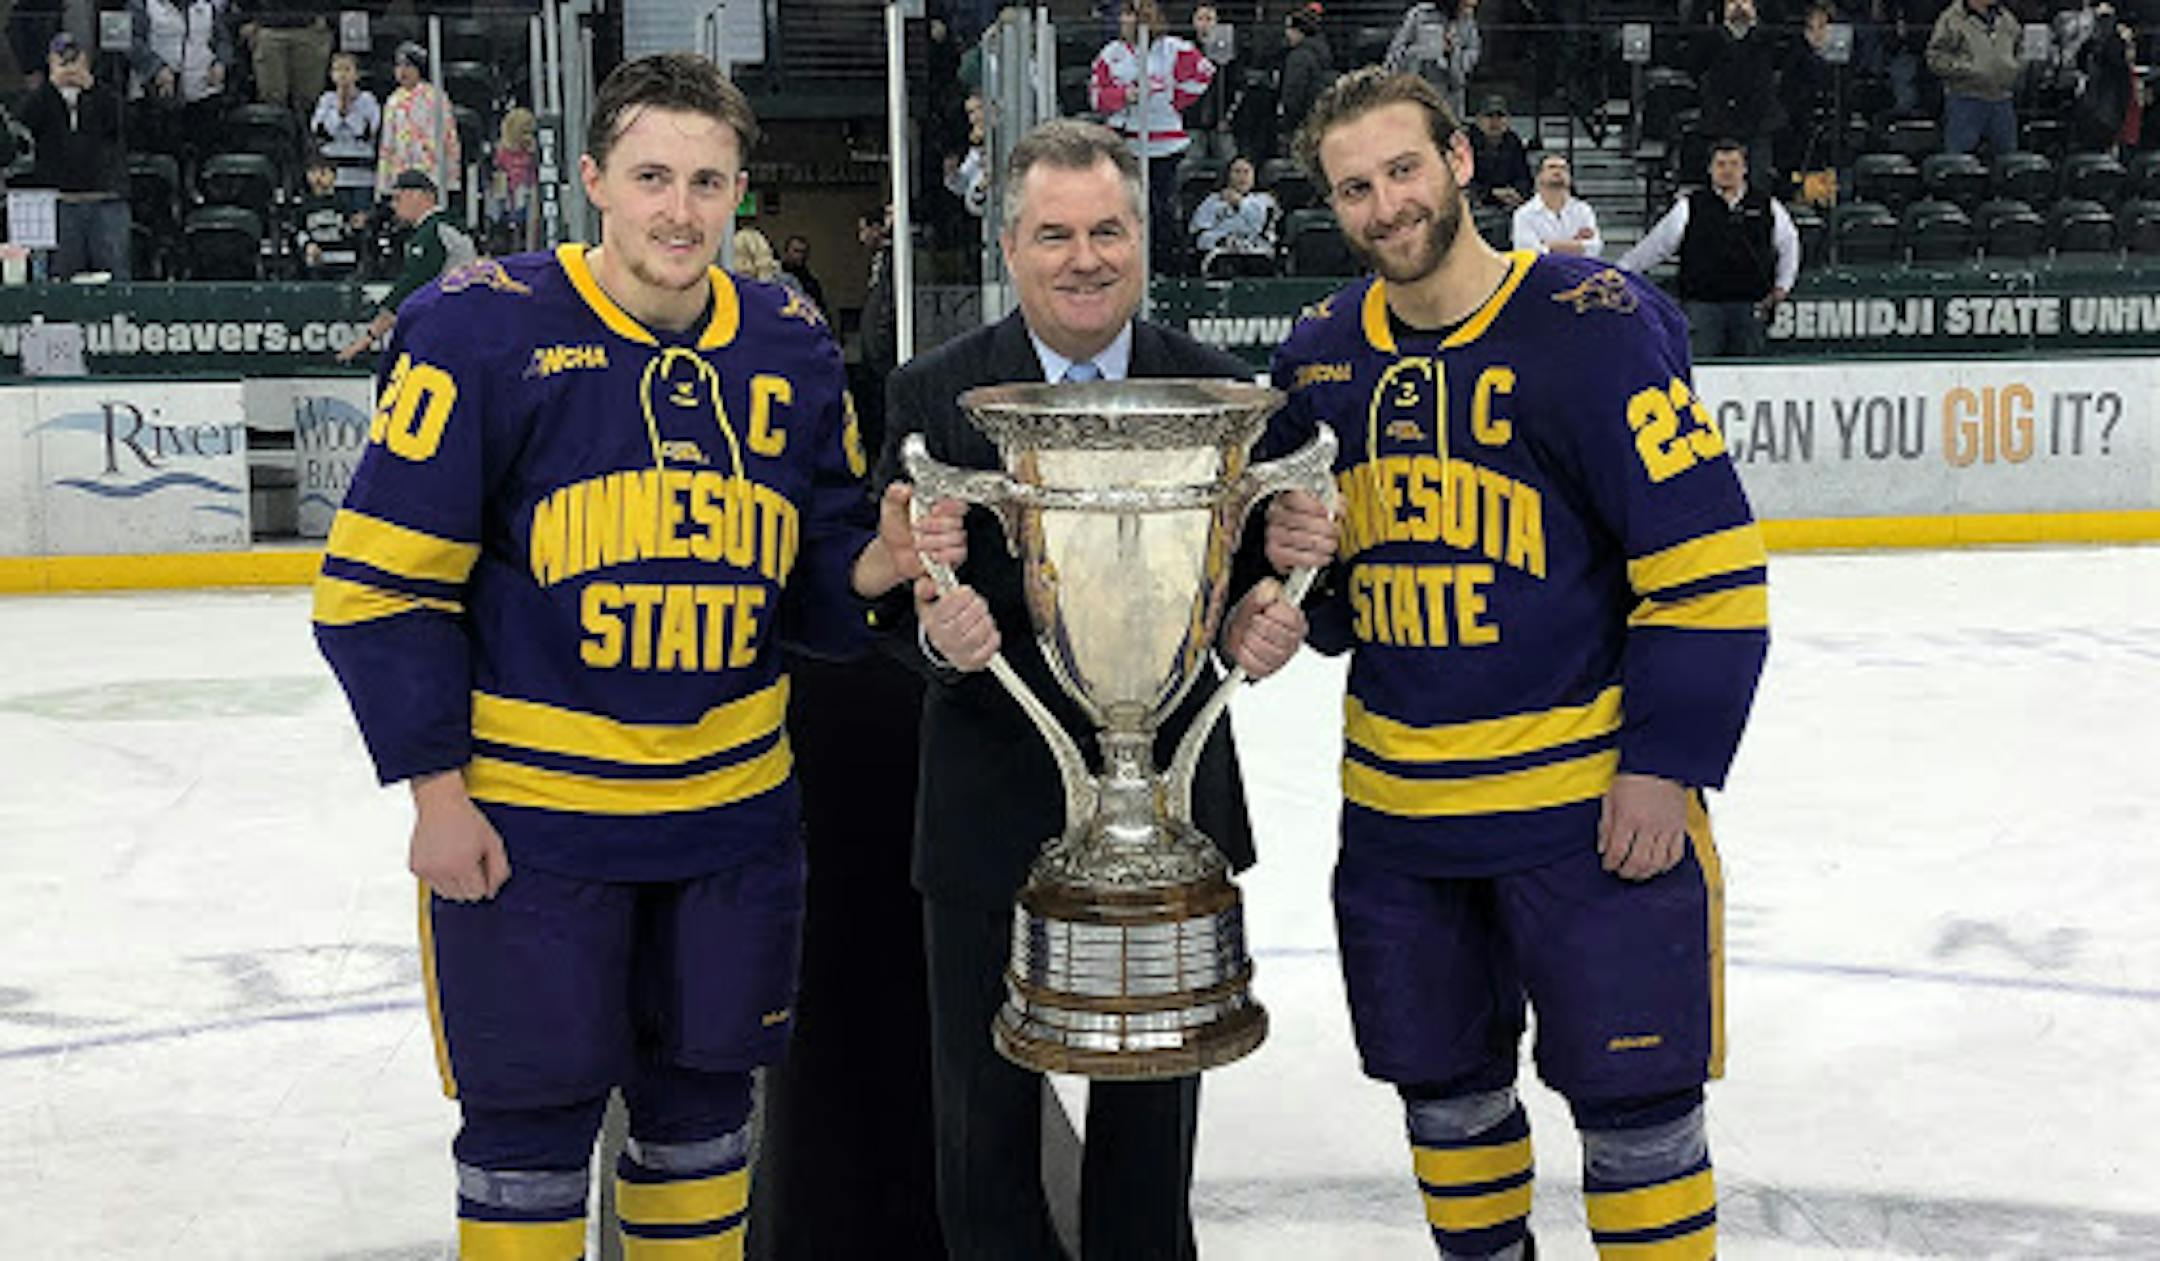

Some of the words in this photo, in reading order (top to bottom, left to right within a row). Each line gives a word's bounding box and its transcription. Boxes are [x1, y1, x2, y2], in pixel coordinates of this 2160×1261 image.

[1766, 299, 1935, 338] BEMIDJI
[1945, 297, 2061, 335] STATE
[98, 400, 242, 474] River
[748, 375, 792, 457] C
[1471, 366, 1516, 446] C
[1717, 400, 1814, 463] CAN
[1831, 395, 1927, 461] YOU
[1942, 383, 2035, 468] GIG
[2050, 391, 2122, 456] IT?
[580, 582, 766, 671] STATE
[1350, 563, 1500, 647] STATE
